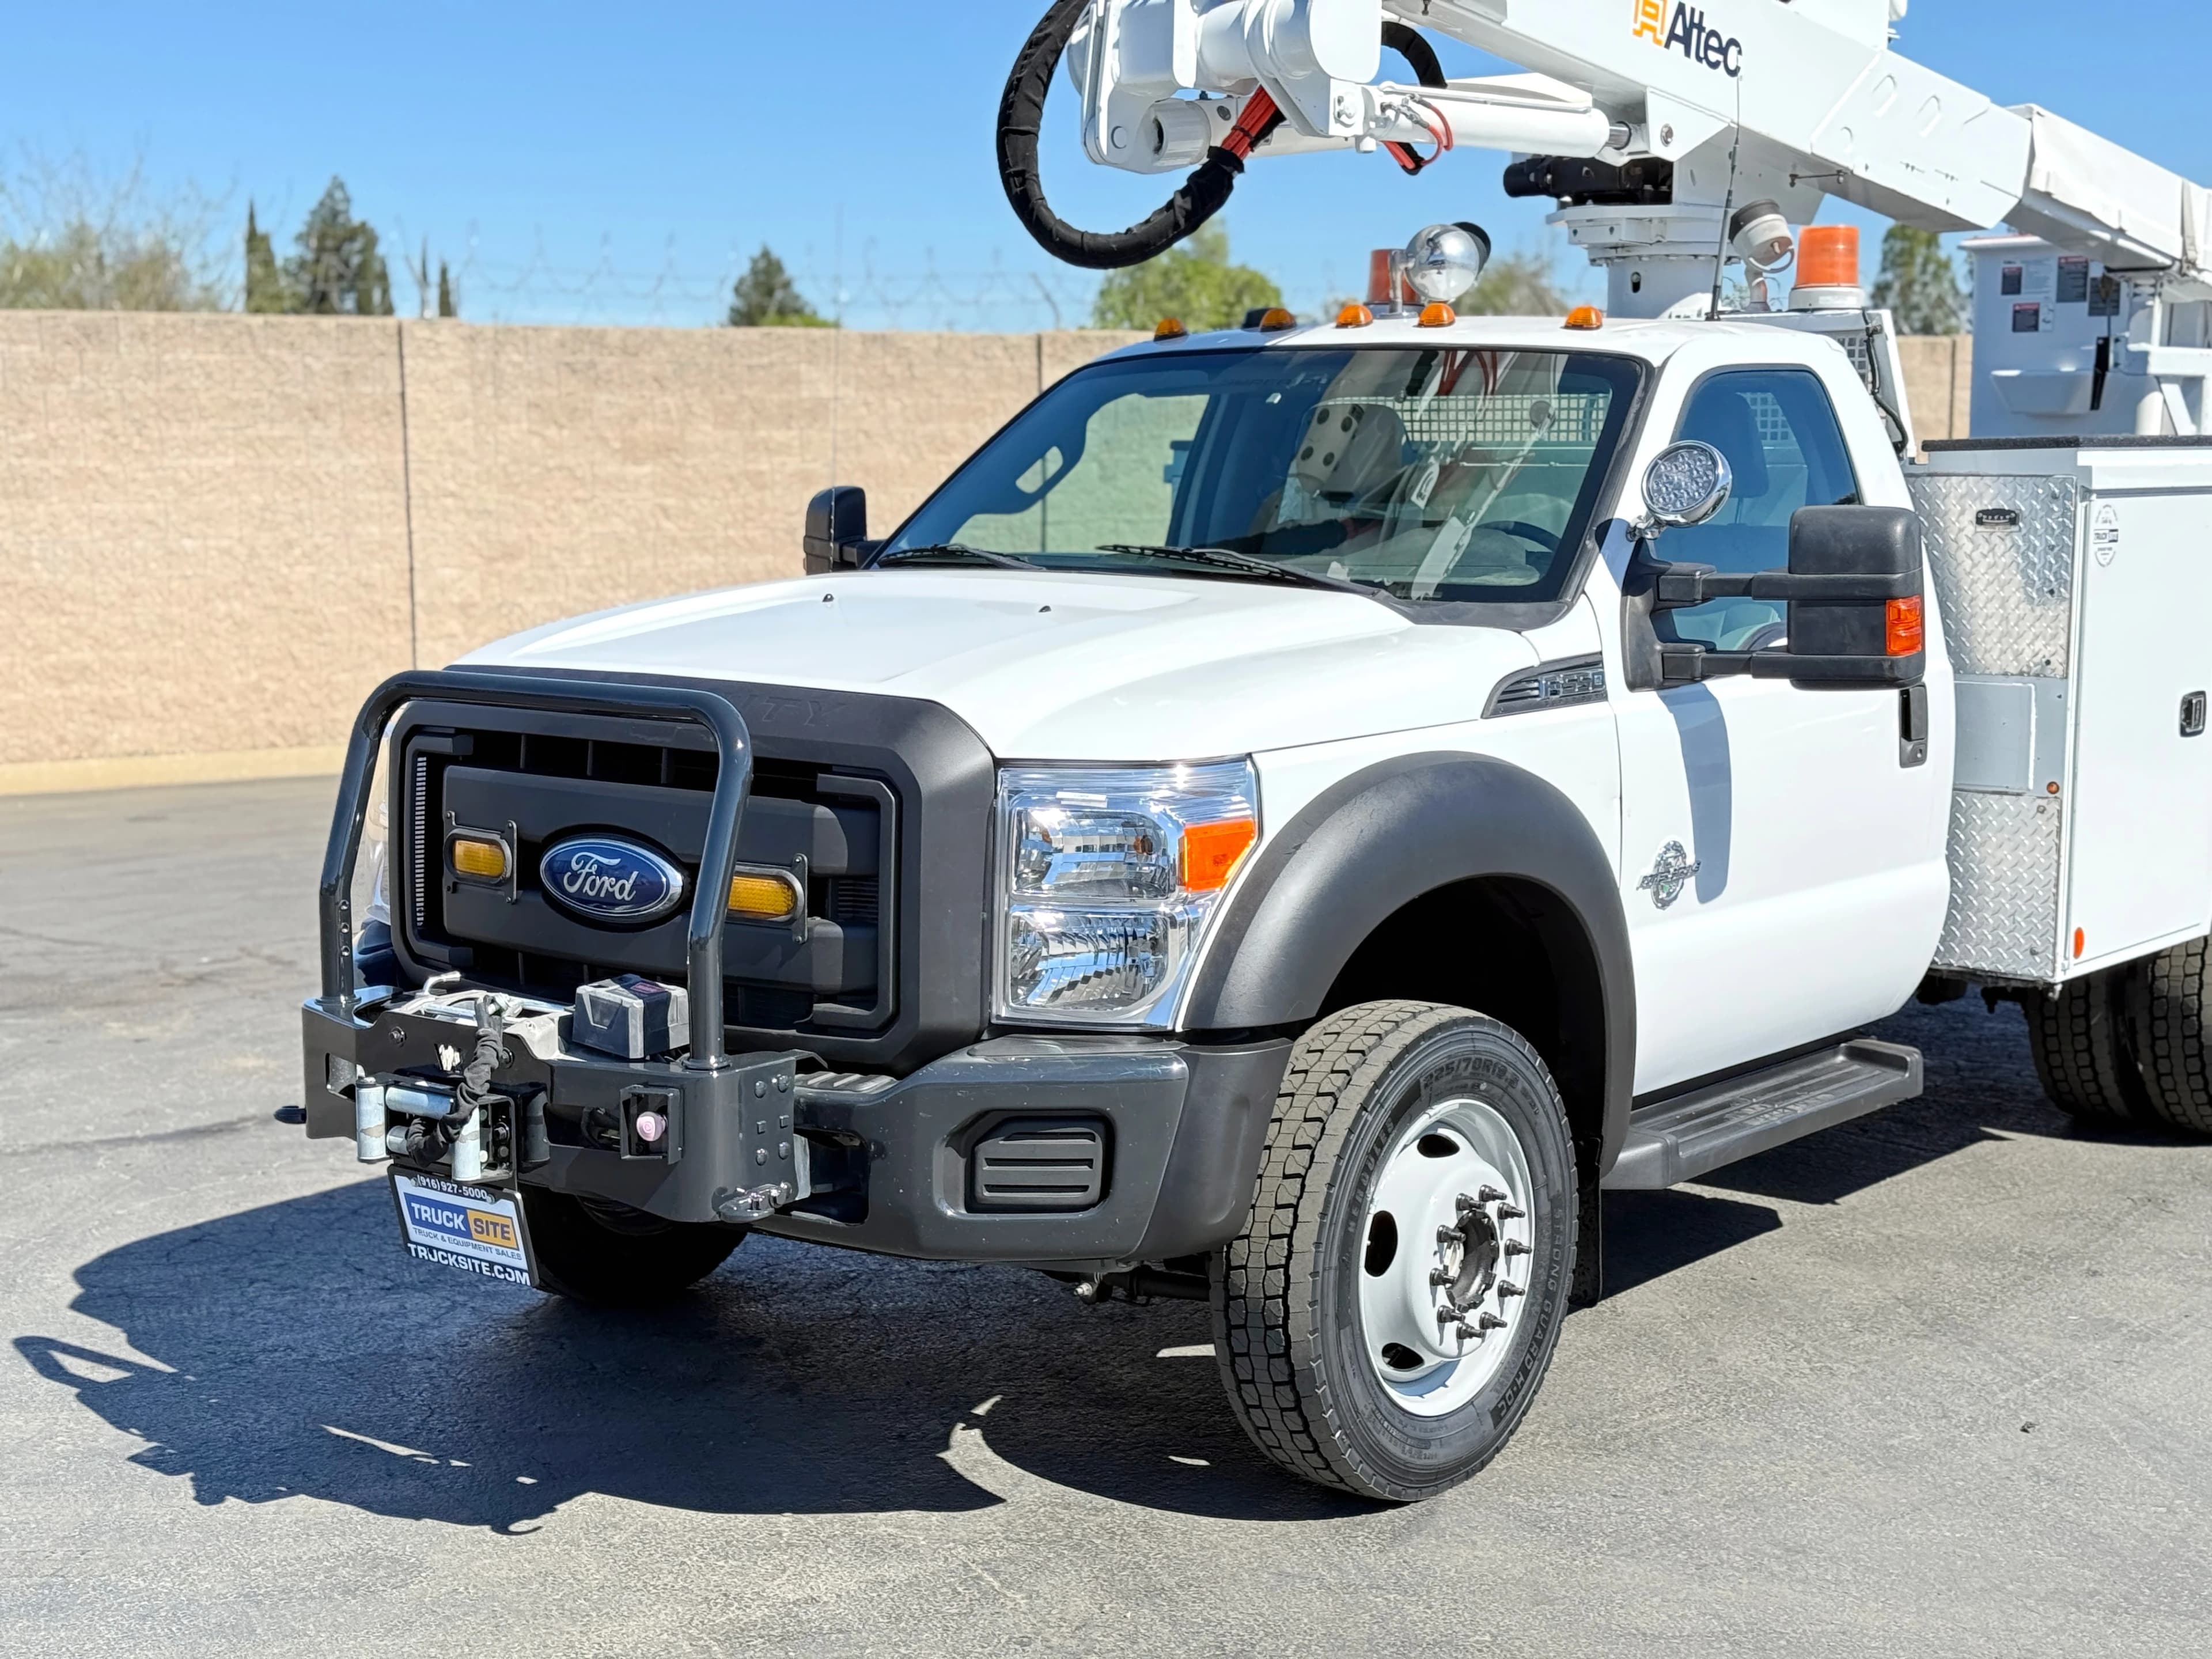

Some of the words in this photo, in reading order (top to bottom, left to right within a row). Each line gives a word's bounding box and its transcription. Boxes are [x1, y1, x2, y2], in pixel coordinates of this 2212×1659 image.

[1664, 1, 1743, 77] Altec
[563, 852, 639, 901] Ford
[411, 1202, 466, 1231] TRUCK
[474, 1218, 511, 1240] SITE
[407, 1243, 531, 1286] TRUCKSITE.COM
[413, 1227, 439, 1241] TRUCK
[447, 1236, 493, 1254] EQUIPMENT
[495, 1248, 522, 1260] SALES
